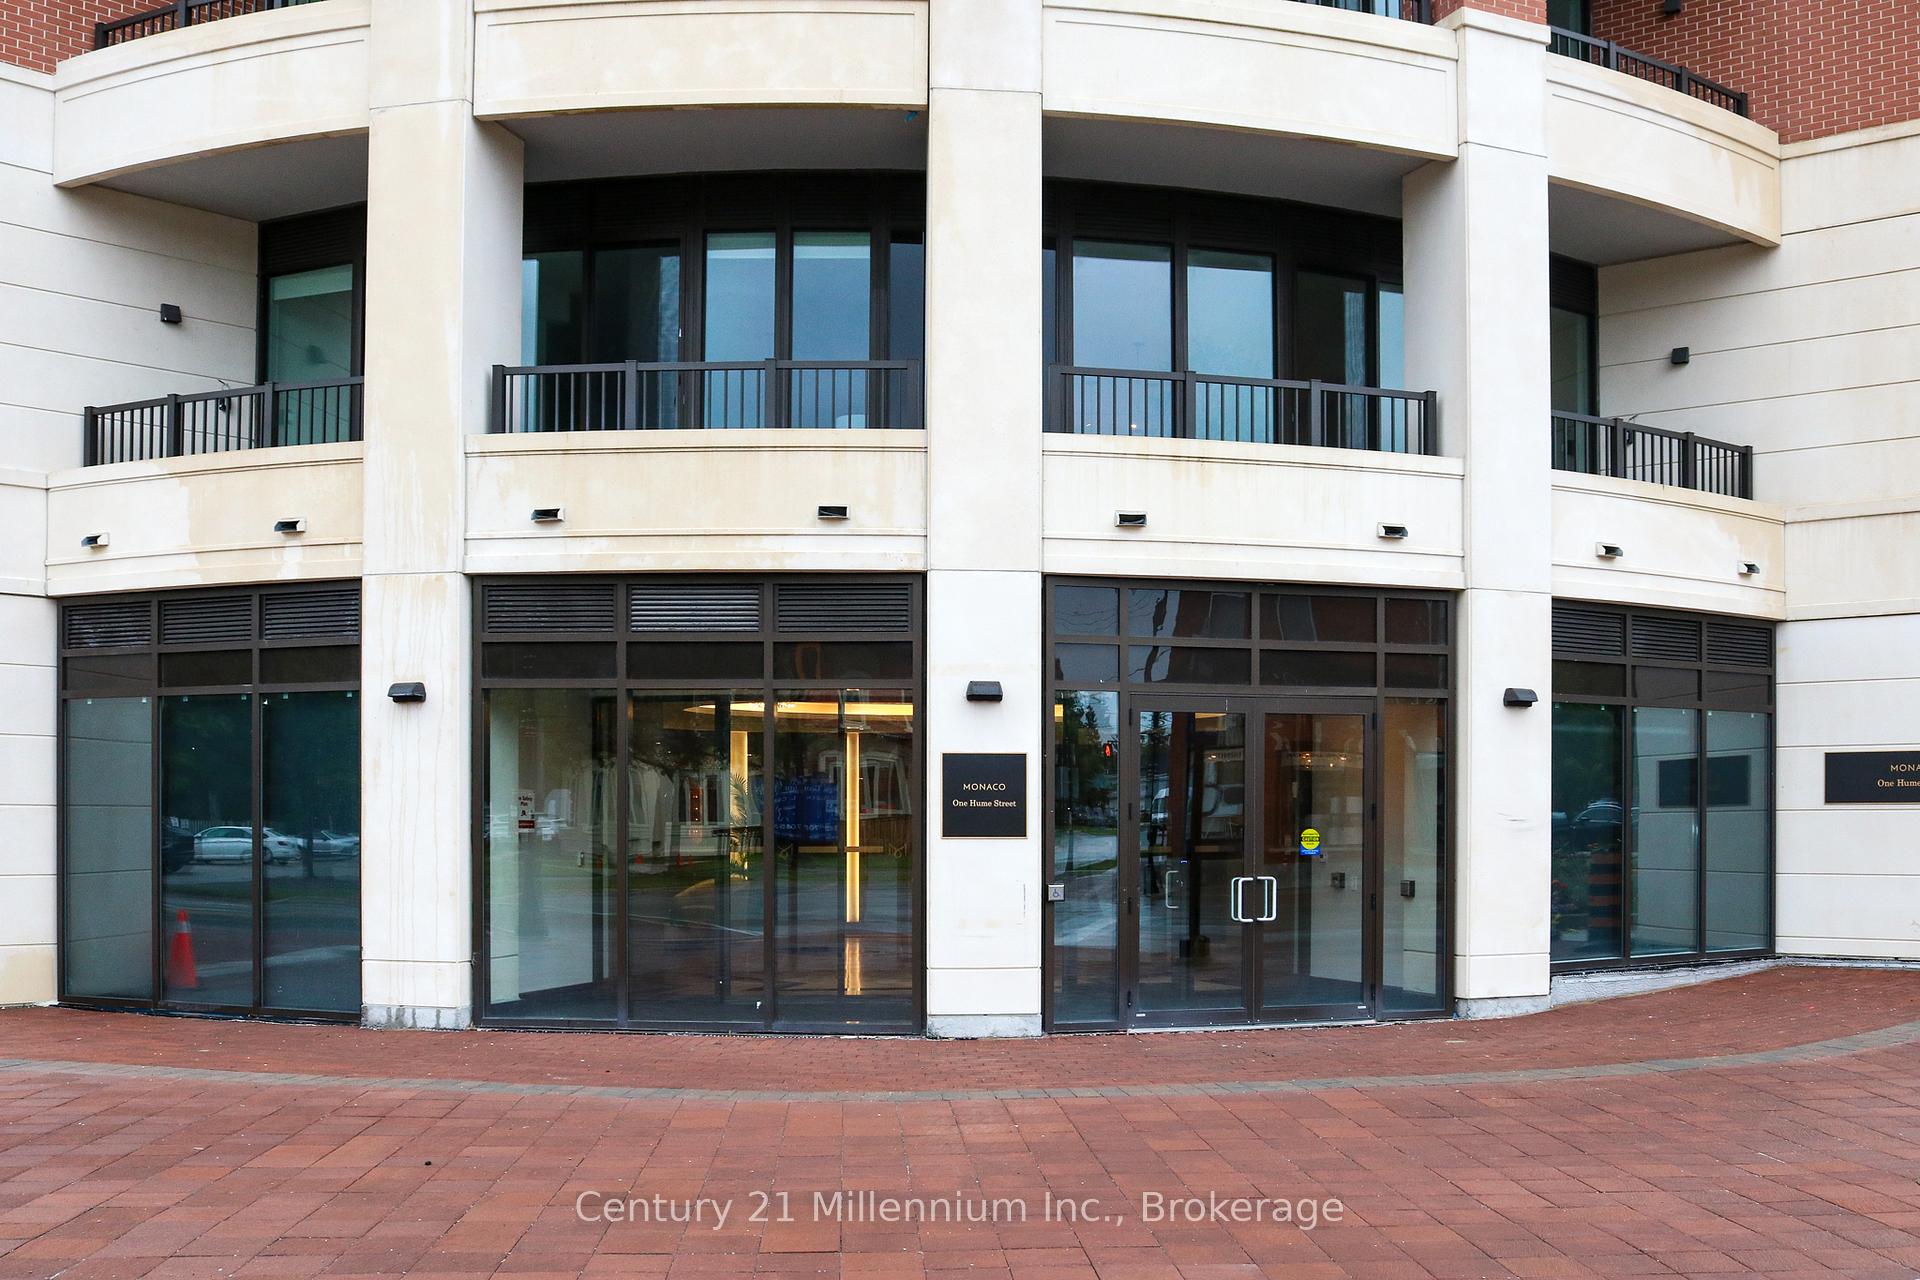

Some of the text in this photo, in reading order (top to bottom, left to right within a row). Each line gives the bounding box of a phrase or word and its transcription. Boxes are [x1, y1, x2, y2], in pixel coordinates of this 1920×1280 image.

[962, 783, 1006, 791] MONACO
[1877, 779, 1920, 787] One Hume
[952, 799, 1017, 807] One Hume Street
